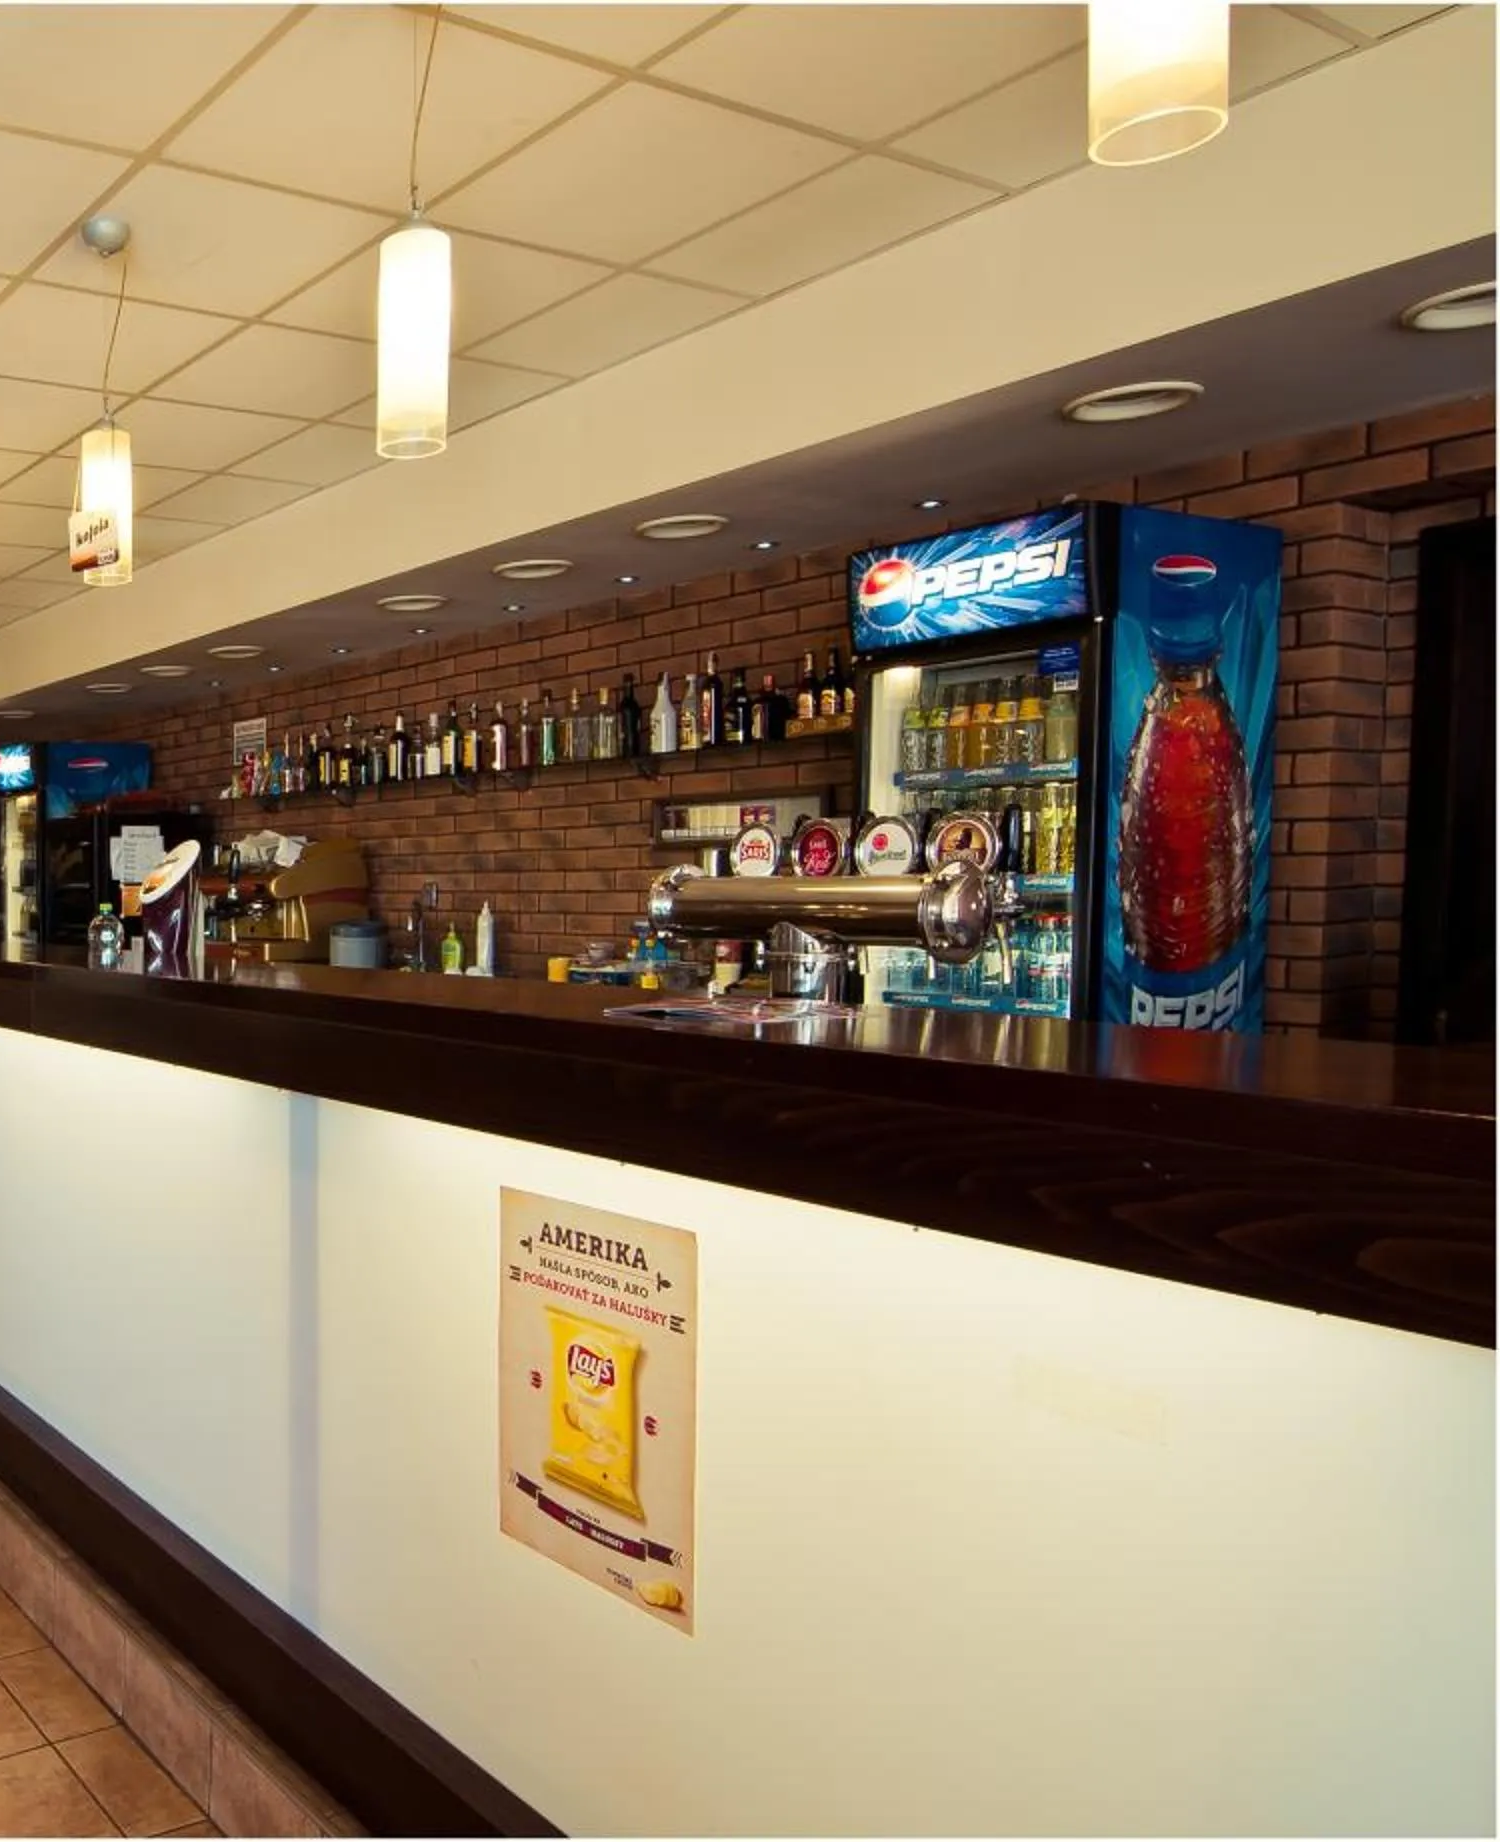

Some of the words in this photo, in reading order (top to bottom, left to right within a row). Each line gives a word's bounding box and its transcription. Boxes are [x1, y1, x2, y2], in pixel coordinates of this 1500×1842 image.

[911, 538, 1072, 606] PEPSI
[539, 1222, 649, 1272] AMERIKA
[591, 1292, 607, 1308] ZA
[623, 1281, 649, 1299] AKO
